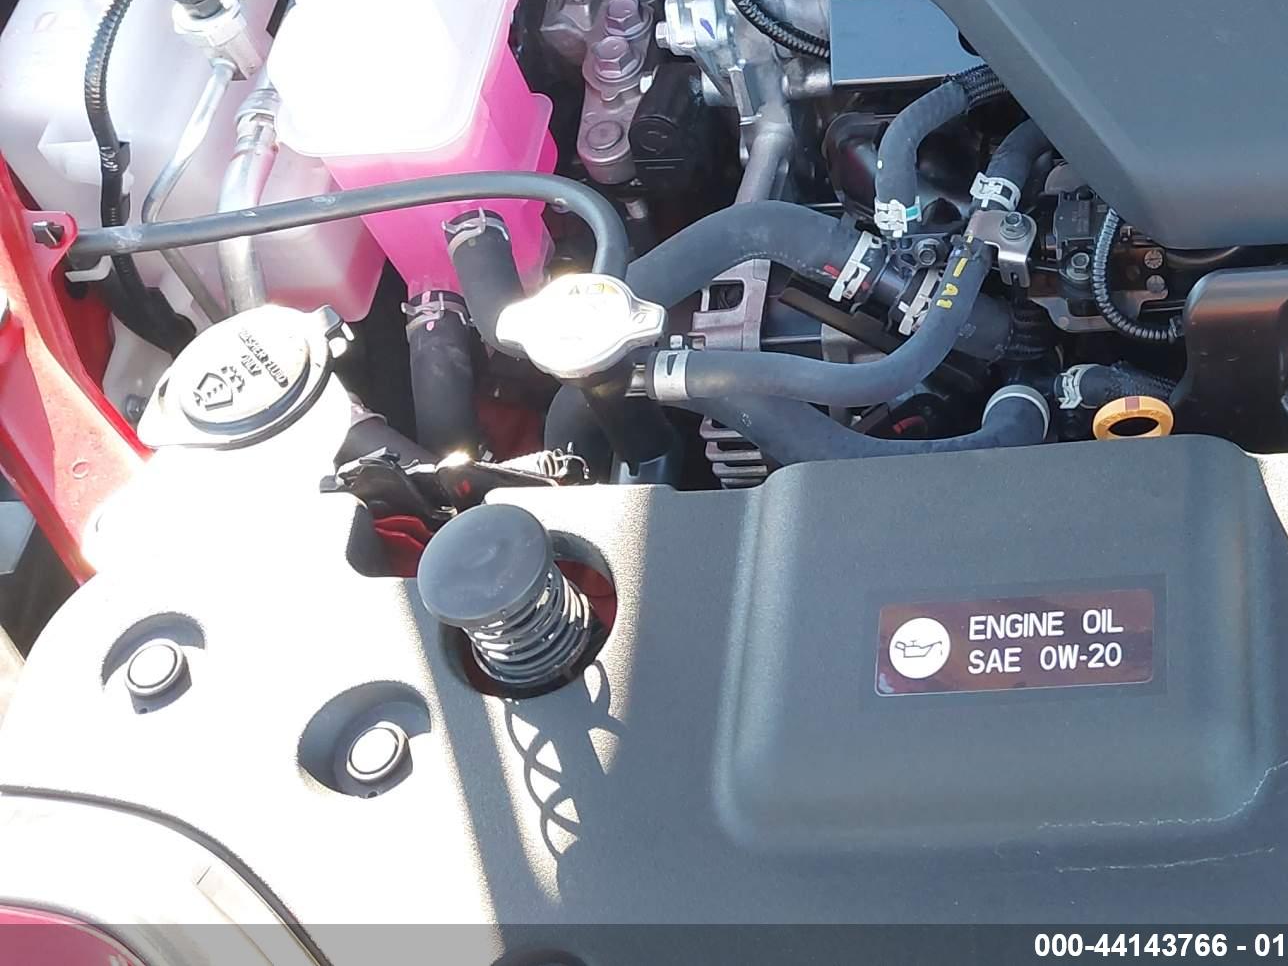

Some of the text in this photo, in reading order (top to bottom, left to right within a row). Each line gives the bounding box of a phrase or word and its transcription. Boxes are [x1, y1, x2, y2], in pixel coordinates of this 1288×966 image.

[968, 608, 1125, 641] ENGINE OIL
[967, 641, 1123, 675] SAE 0W-20
